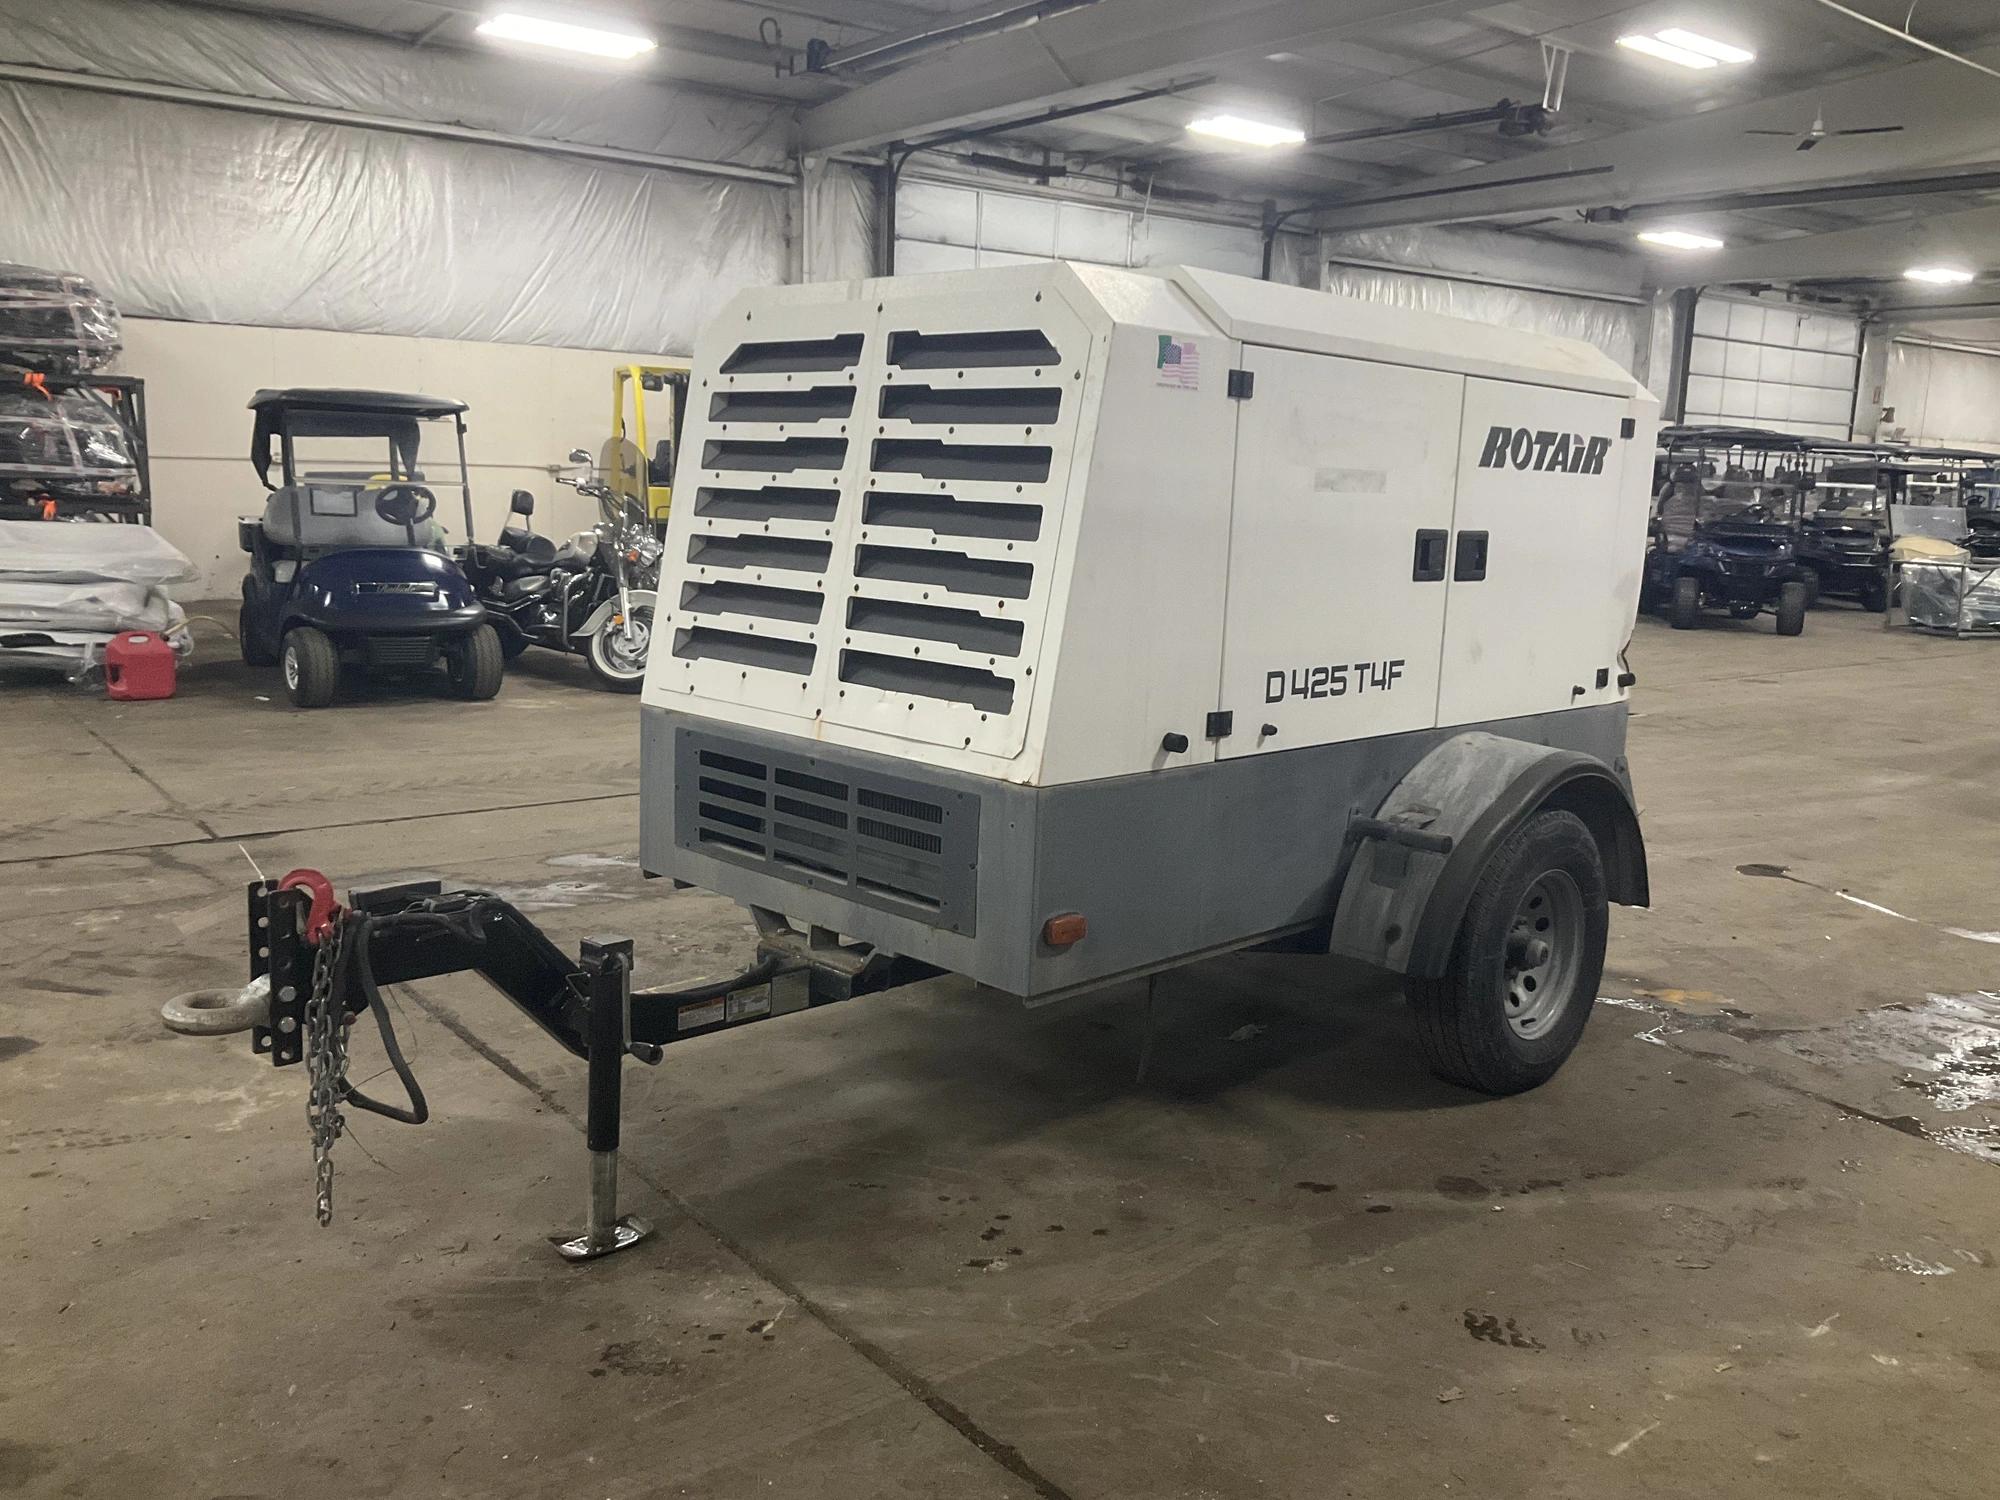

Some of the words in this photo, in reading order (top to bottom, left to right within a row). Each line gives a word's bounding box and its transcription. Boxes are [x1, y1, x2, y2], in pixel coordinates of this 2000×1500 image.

[1265, 670, 1286, 704] D
[1291, 664, 1349, 700] 425
[1354, 659, 1405, 693] T4F
